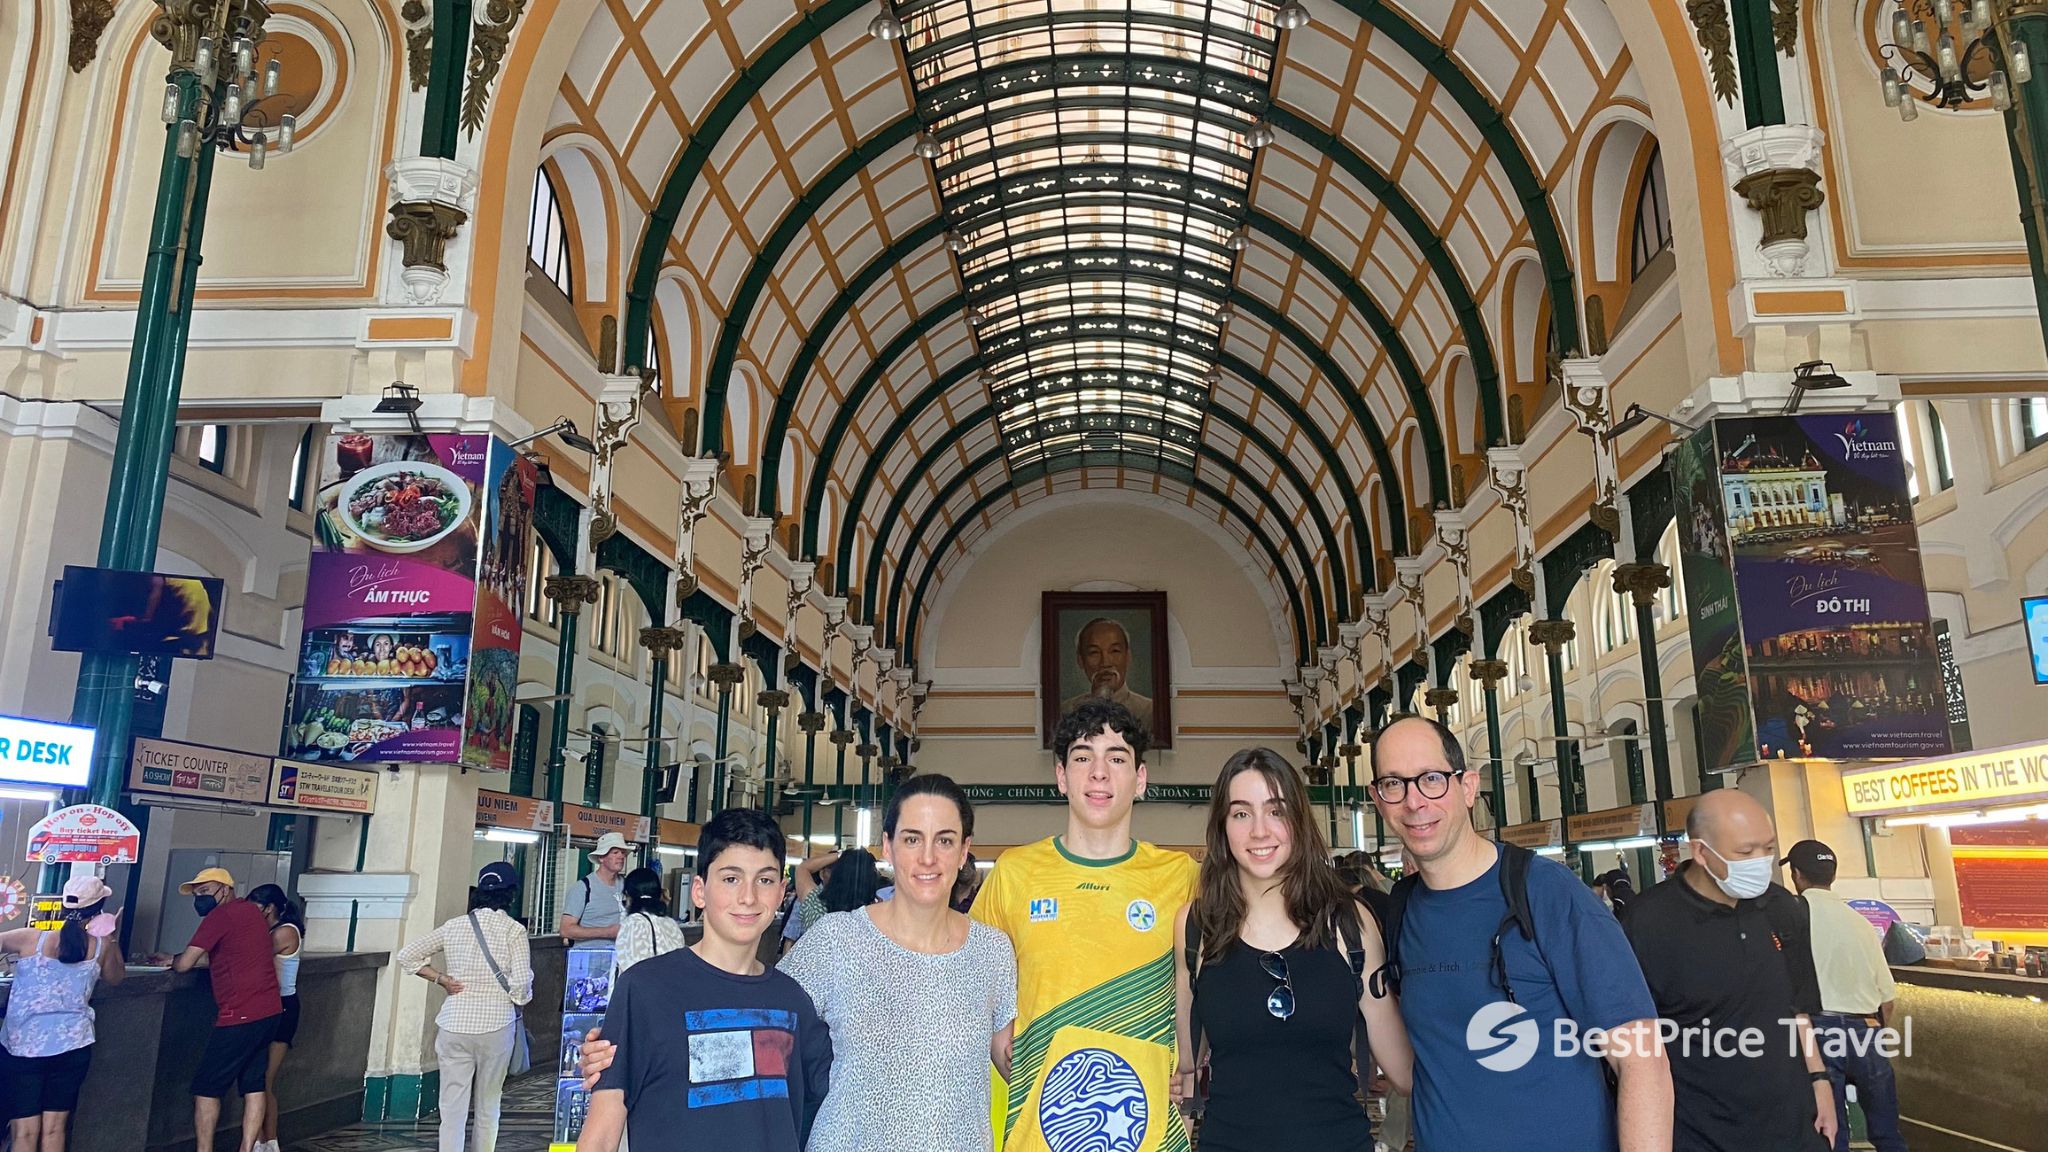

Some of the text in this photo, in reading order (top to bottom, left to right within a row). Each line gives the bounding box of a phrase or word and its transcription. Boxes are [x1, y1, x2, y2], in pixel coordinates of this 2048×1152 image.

[449, 447, 485, 466] Vietnam
[1833, 432, 1896, 461] Vietnam
[363, 585, 430, 606] ẨM THỰC
[1816, 596, 1870, 615] ĐÔ THỊ
[1870, 730, 1943, 738] www.vietnam.travel
[16, 739, 73, 766] DESK
[379, 748, 454, 756] www.vietnamtourism.gov.vn
[1842, 741, 1945, 750] www.vietnamtourism.gov.vn
[145, 750, 229, 774] TICKET COUNTER
[1008, 785, 1044, 797] CHÍNH
[1853, 778, 1886, 803] BEST
[1890, 768, 1959, 800] COFFEES
[1961, 766, 1980, 791] IN
[1980, 760, 2019, 788] THE
[43, 812, 67, 829] Hop
[93, 806, 115, 819] Hop
[115, 817, 131, 832] off
